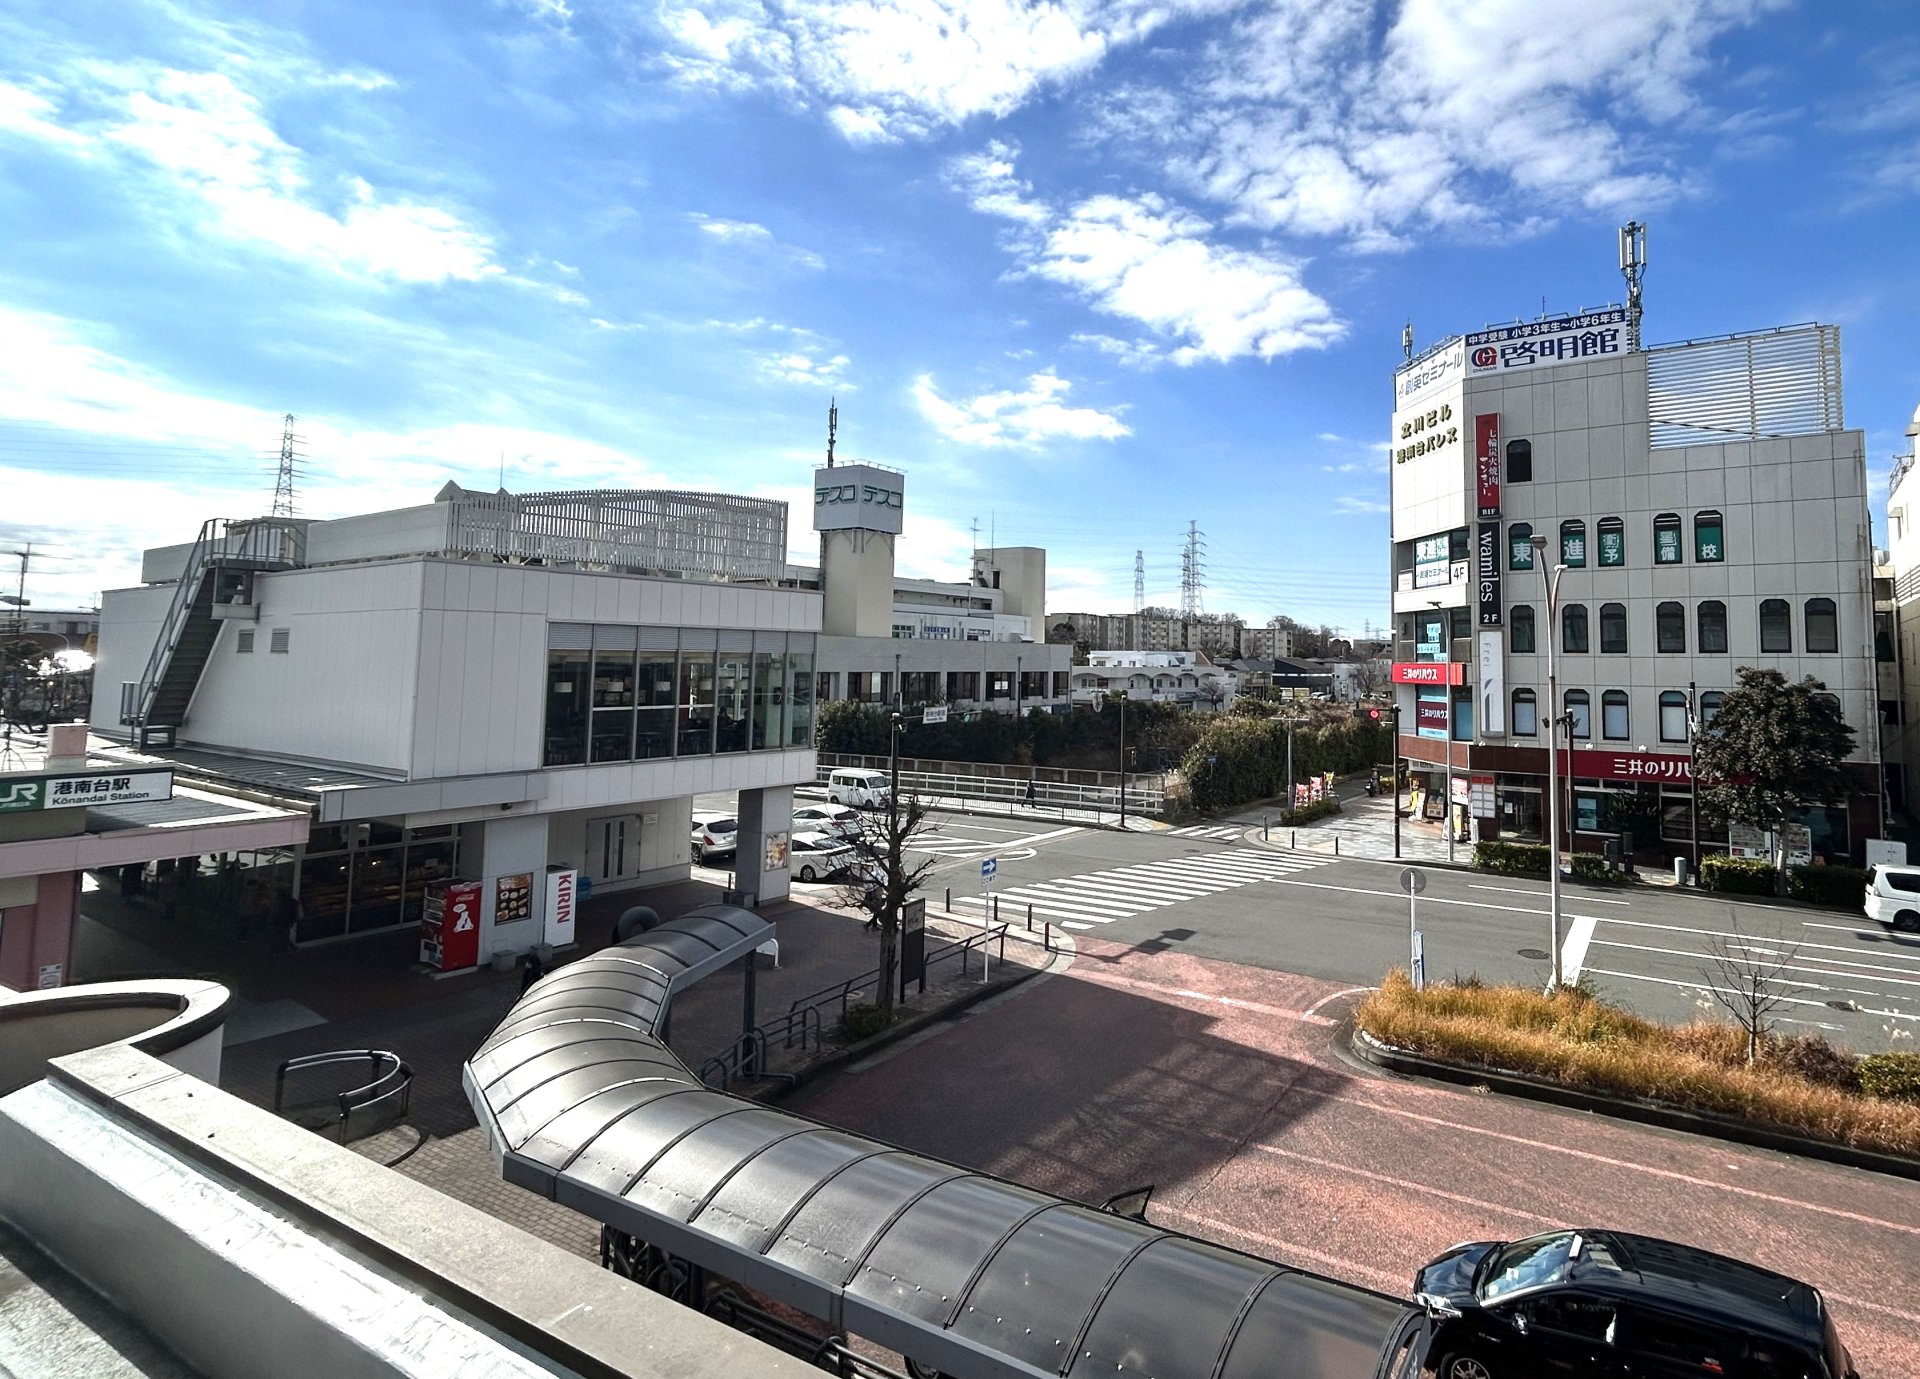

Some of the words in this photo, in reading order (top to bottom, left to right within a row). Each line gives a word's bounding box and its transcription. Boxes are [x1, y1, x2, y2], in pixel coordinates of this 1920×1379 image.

[1468, 330, 1509, 345] 中学受験
[1500, 328, 1620, 368] 啓明館
[1400, 404, 1452, 440] 立川ビル
[815, 484, 856, 505] テスコ
[863, 484, 903, 509] テスコ
[1453, 566, 1465, 581] 4F
[1480, 531, 1500, 602] wamiles
[1613, 758, 1706, 778] 三井のリハ
[0, 783, 38, 803] JR
[54, 777, 131, 796] 港南台駅
[109, 791, 150, 802] Station
[556, 873, 572, 924] KIRIN
